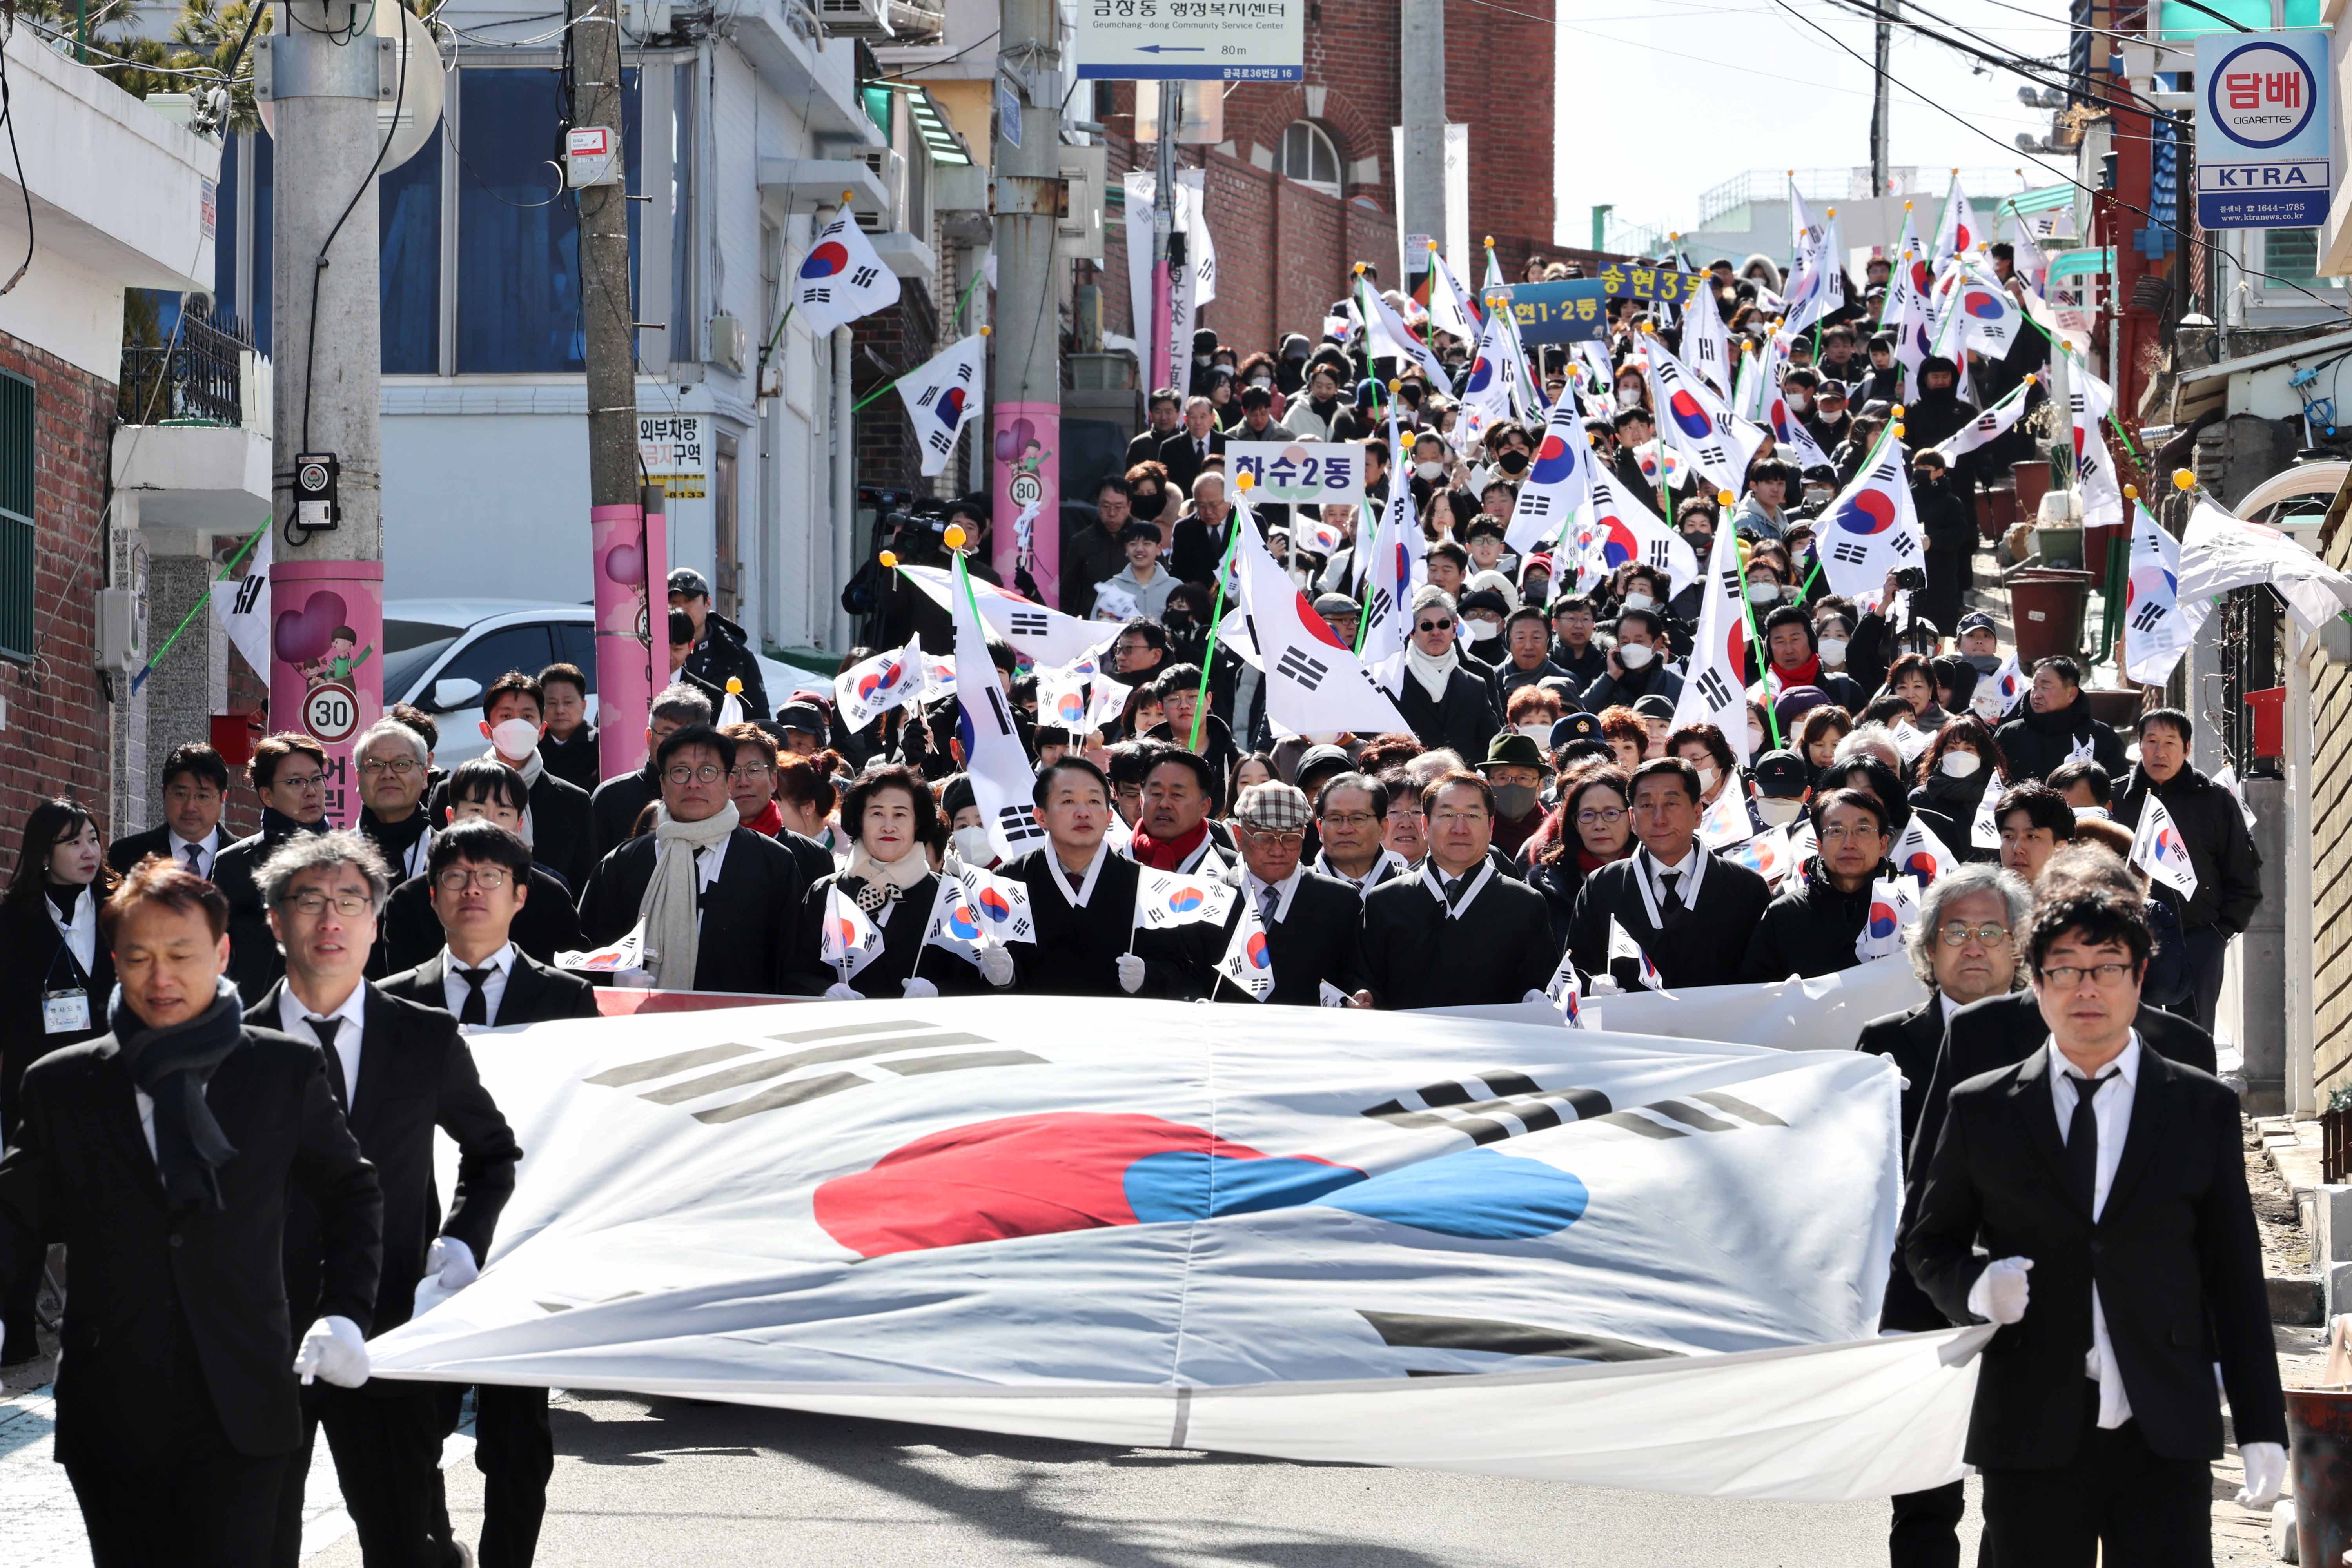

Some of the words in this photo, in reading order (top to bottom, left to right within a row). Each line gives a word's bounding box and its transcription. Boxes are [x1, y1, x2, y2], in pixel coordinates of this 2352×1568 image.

[1093, 21, 1169, 29] Geumchang-dong
[1172, 21, 1219, 30] Community
[1223, 69, 1278, 78] 금곡로36번길
[1282, 69, 1292, 78] 16
[2226, 72, 2300, 109] 담배
[2234, 115, 2292, 125] CIGARETTES
[2219, 167, 2307, 186] KTRA
[2258, 203, 2305, 212] 1644-1785
[2221, 212, 2303, 221] www.ktranews.co.kr
[641, 419, 697, 441] 외부차량
[1016, 483, 1035, 499] 30
[316, 701, 347, 726] 30
